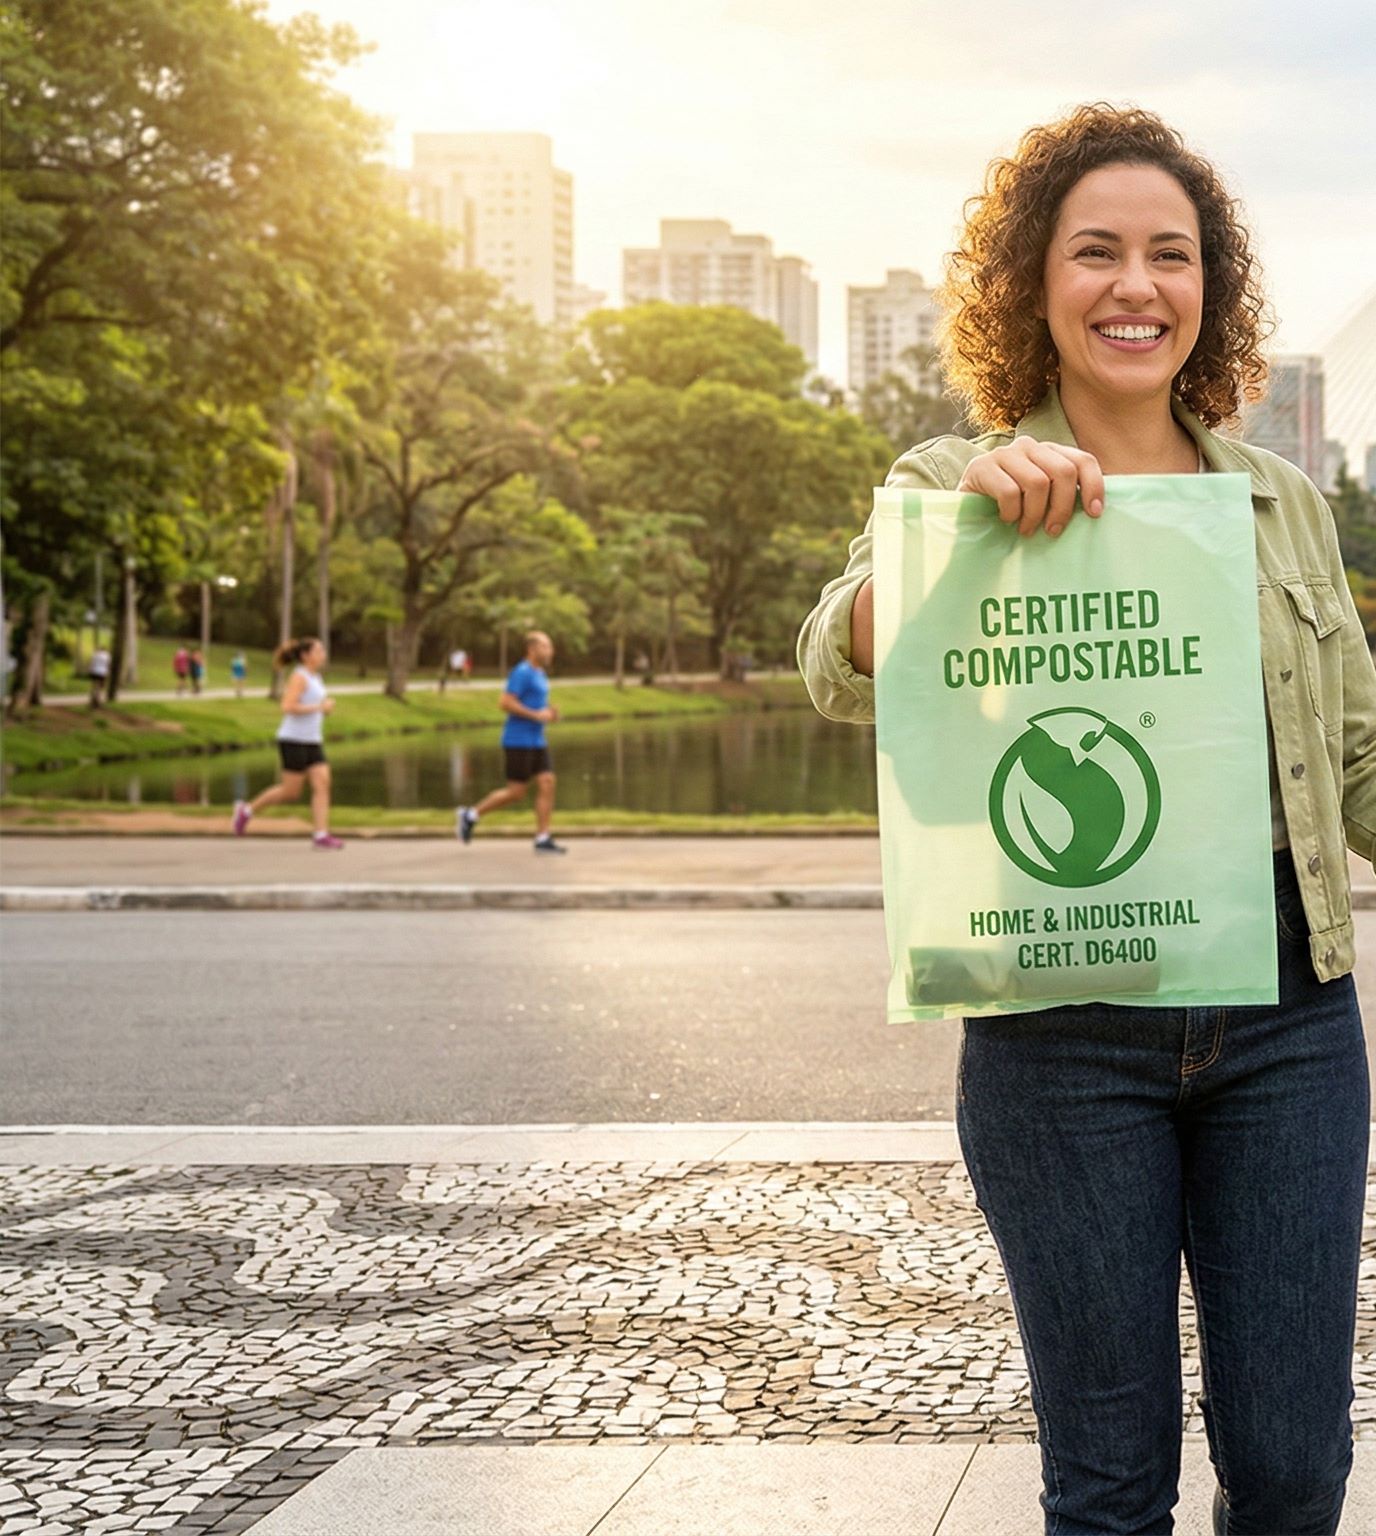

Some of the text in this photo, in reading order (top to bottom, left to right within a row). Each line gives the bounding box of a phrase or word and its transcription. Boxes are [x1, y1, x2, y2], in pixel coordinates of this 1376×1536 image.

[980, 589, 1160, 638] CERTIFIED
[943, 636, 1202, 689] COMPOSTABLE
[970, 899, 1200, 937] HOME & INDUSTRIAL
[1018, 936, 1157, 969] CERT. D6400
